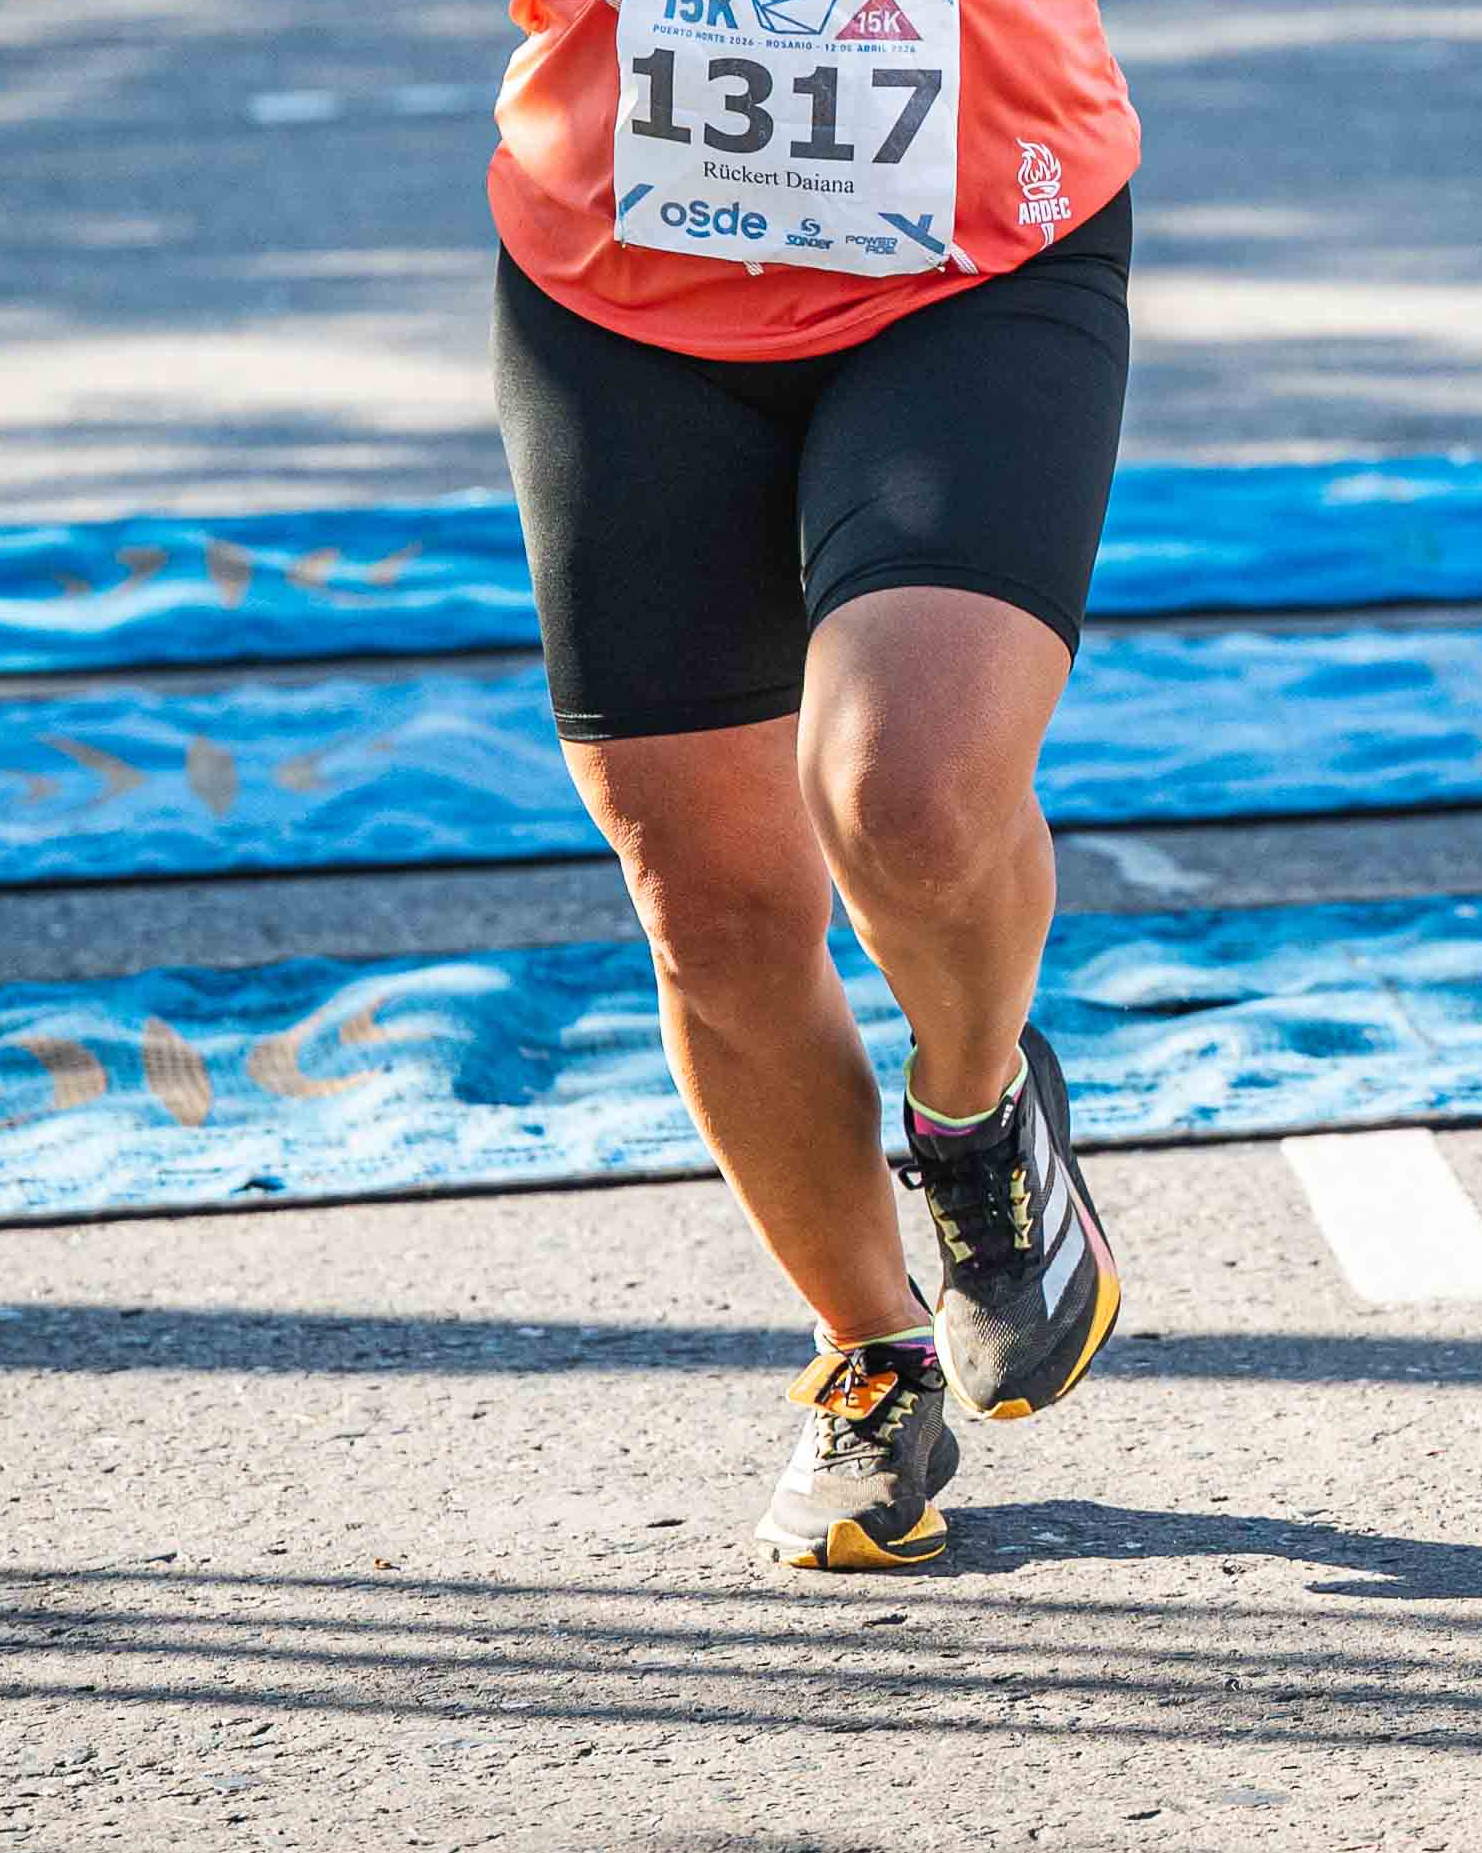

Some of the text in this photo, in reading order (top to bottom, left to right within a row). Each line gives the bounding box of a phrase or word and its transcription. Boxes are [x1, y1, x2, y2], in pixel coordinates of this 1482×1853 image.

[857, 10, 902, 34] 15K
[653, 24, 693, 37] PUERTO
[695, 32, 725, 43] NORTE
[729, 37, 754, 46] 2026
[766, 40, 812, 50] ROSARIO
[631, 47, 943, 164] 1317
[703, 161, 855, 194] Rückert Daiana
[1018, 196, 1072, 226] ARDEC
[845, 235, 898, 247] POWER
